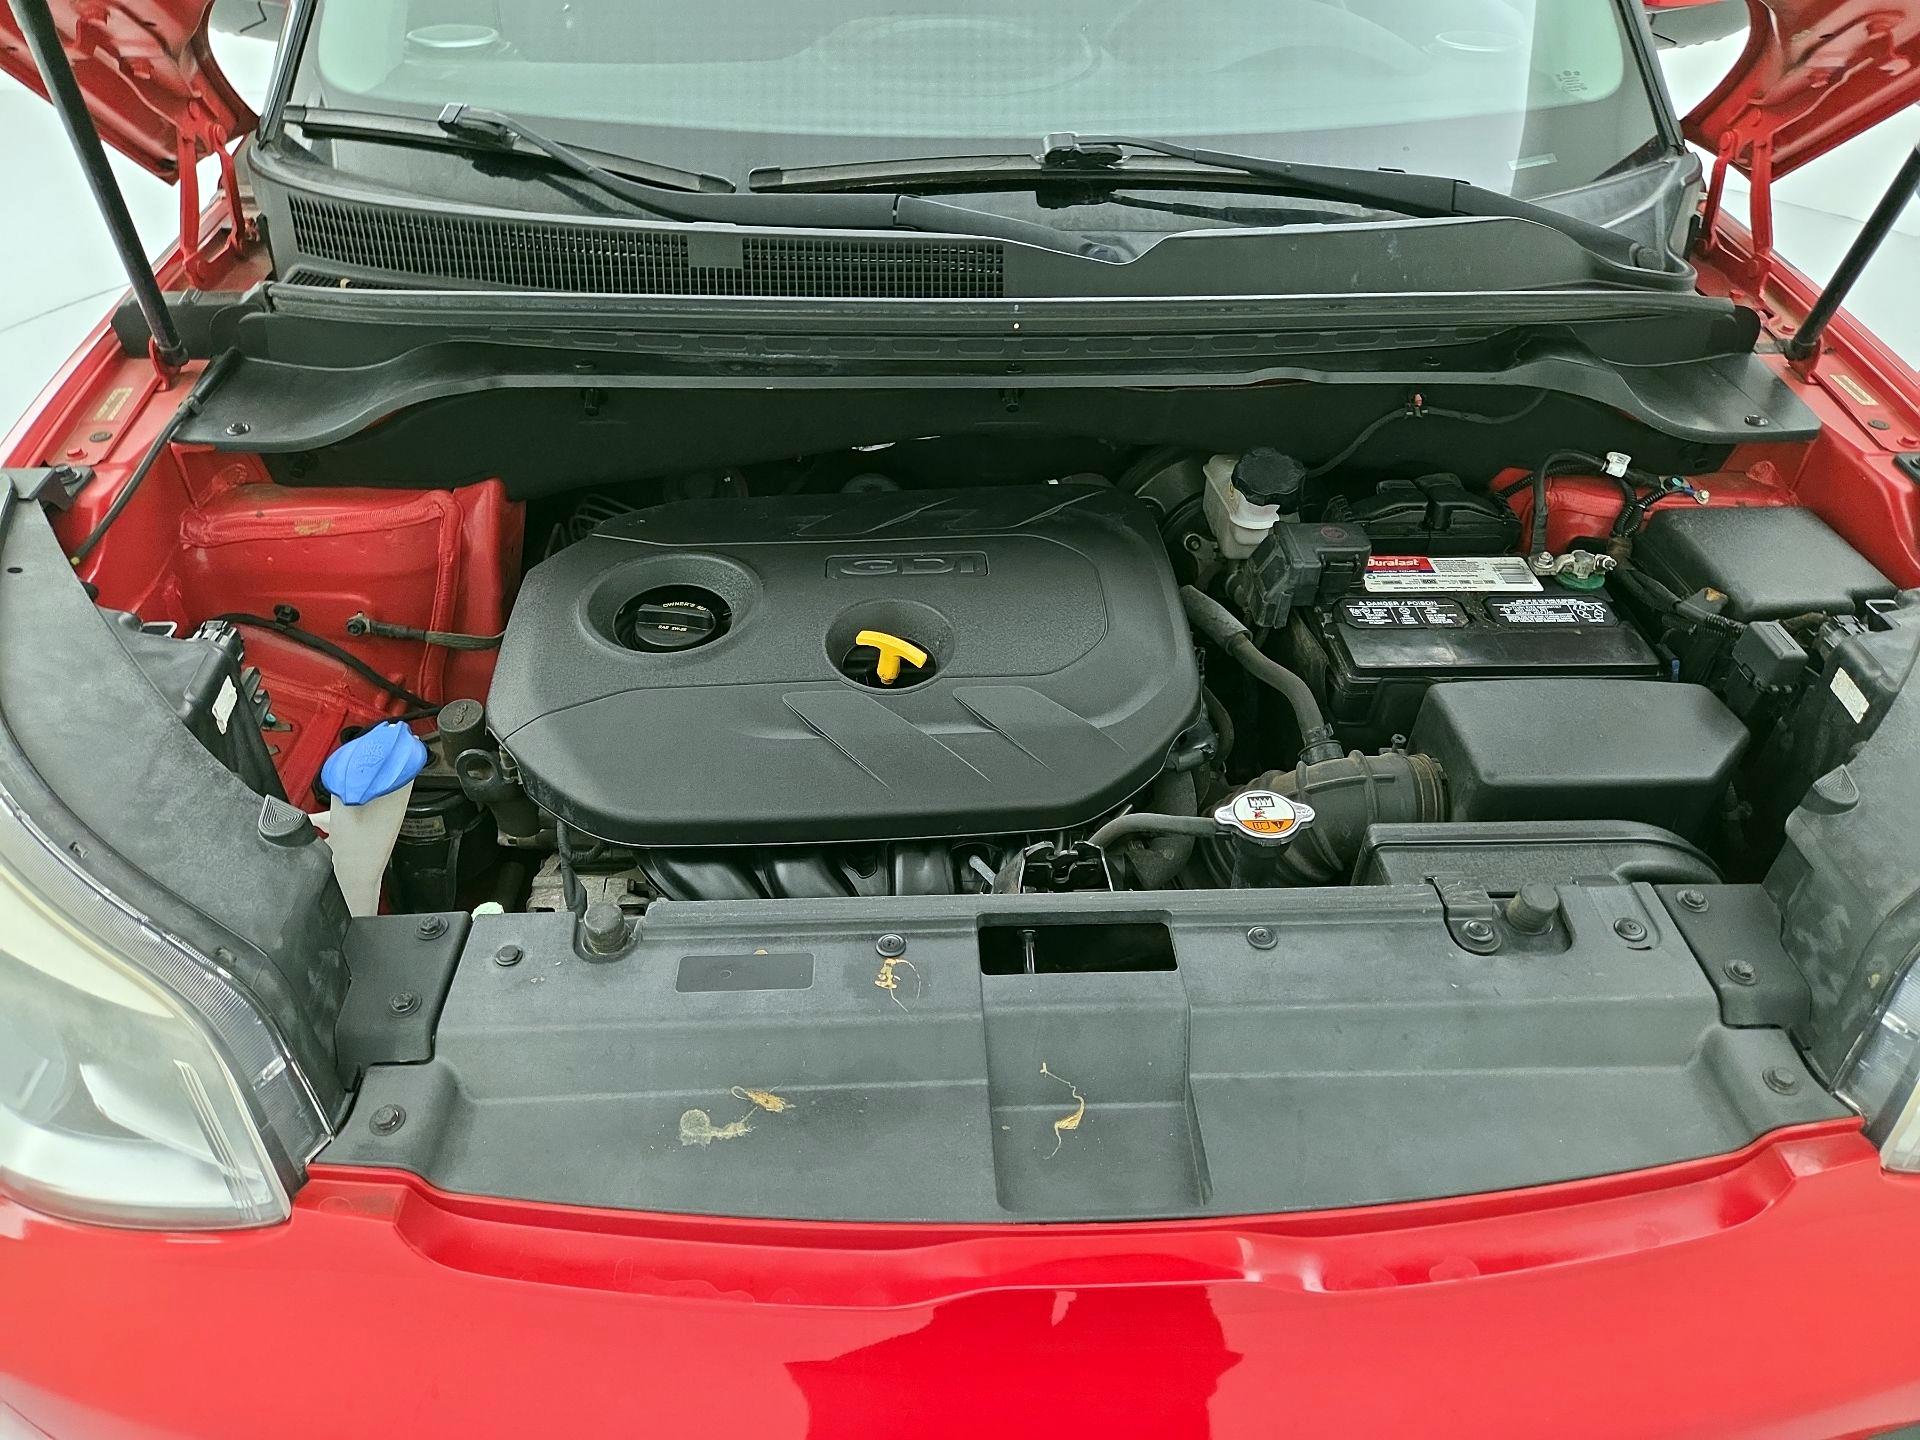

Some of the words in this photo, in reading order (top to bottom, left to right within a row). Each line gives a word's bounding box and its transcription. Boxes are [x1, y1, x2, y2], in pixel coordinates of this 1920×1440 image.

[841, 558, 974, 575] GDI
[1367, 558, 1420, 567] Duralast
[662, 601, 696, 609] OWNER'S
